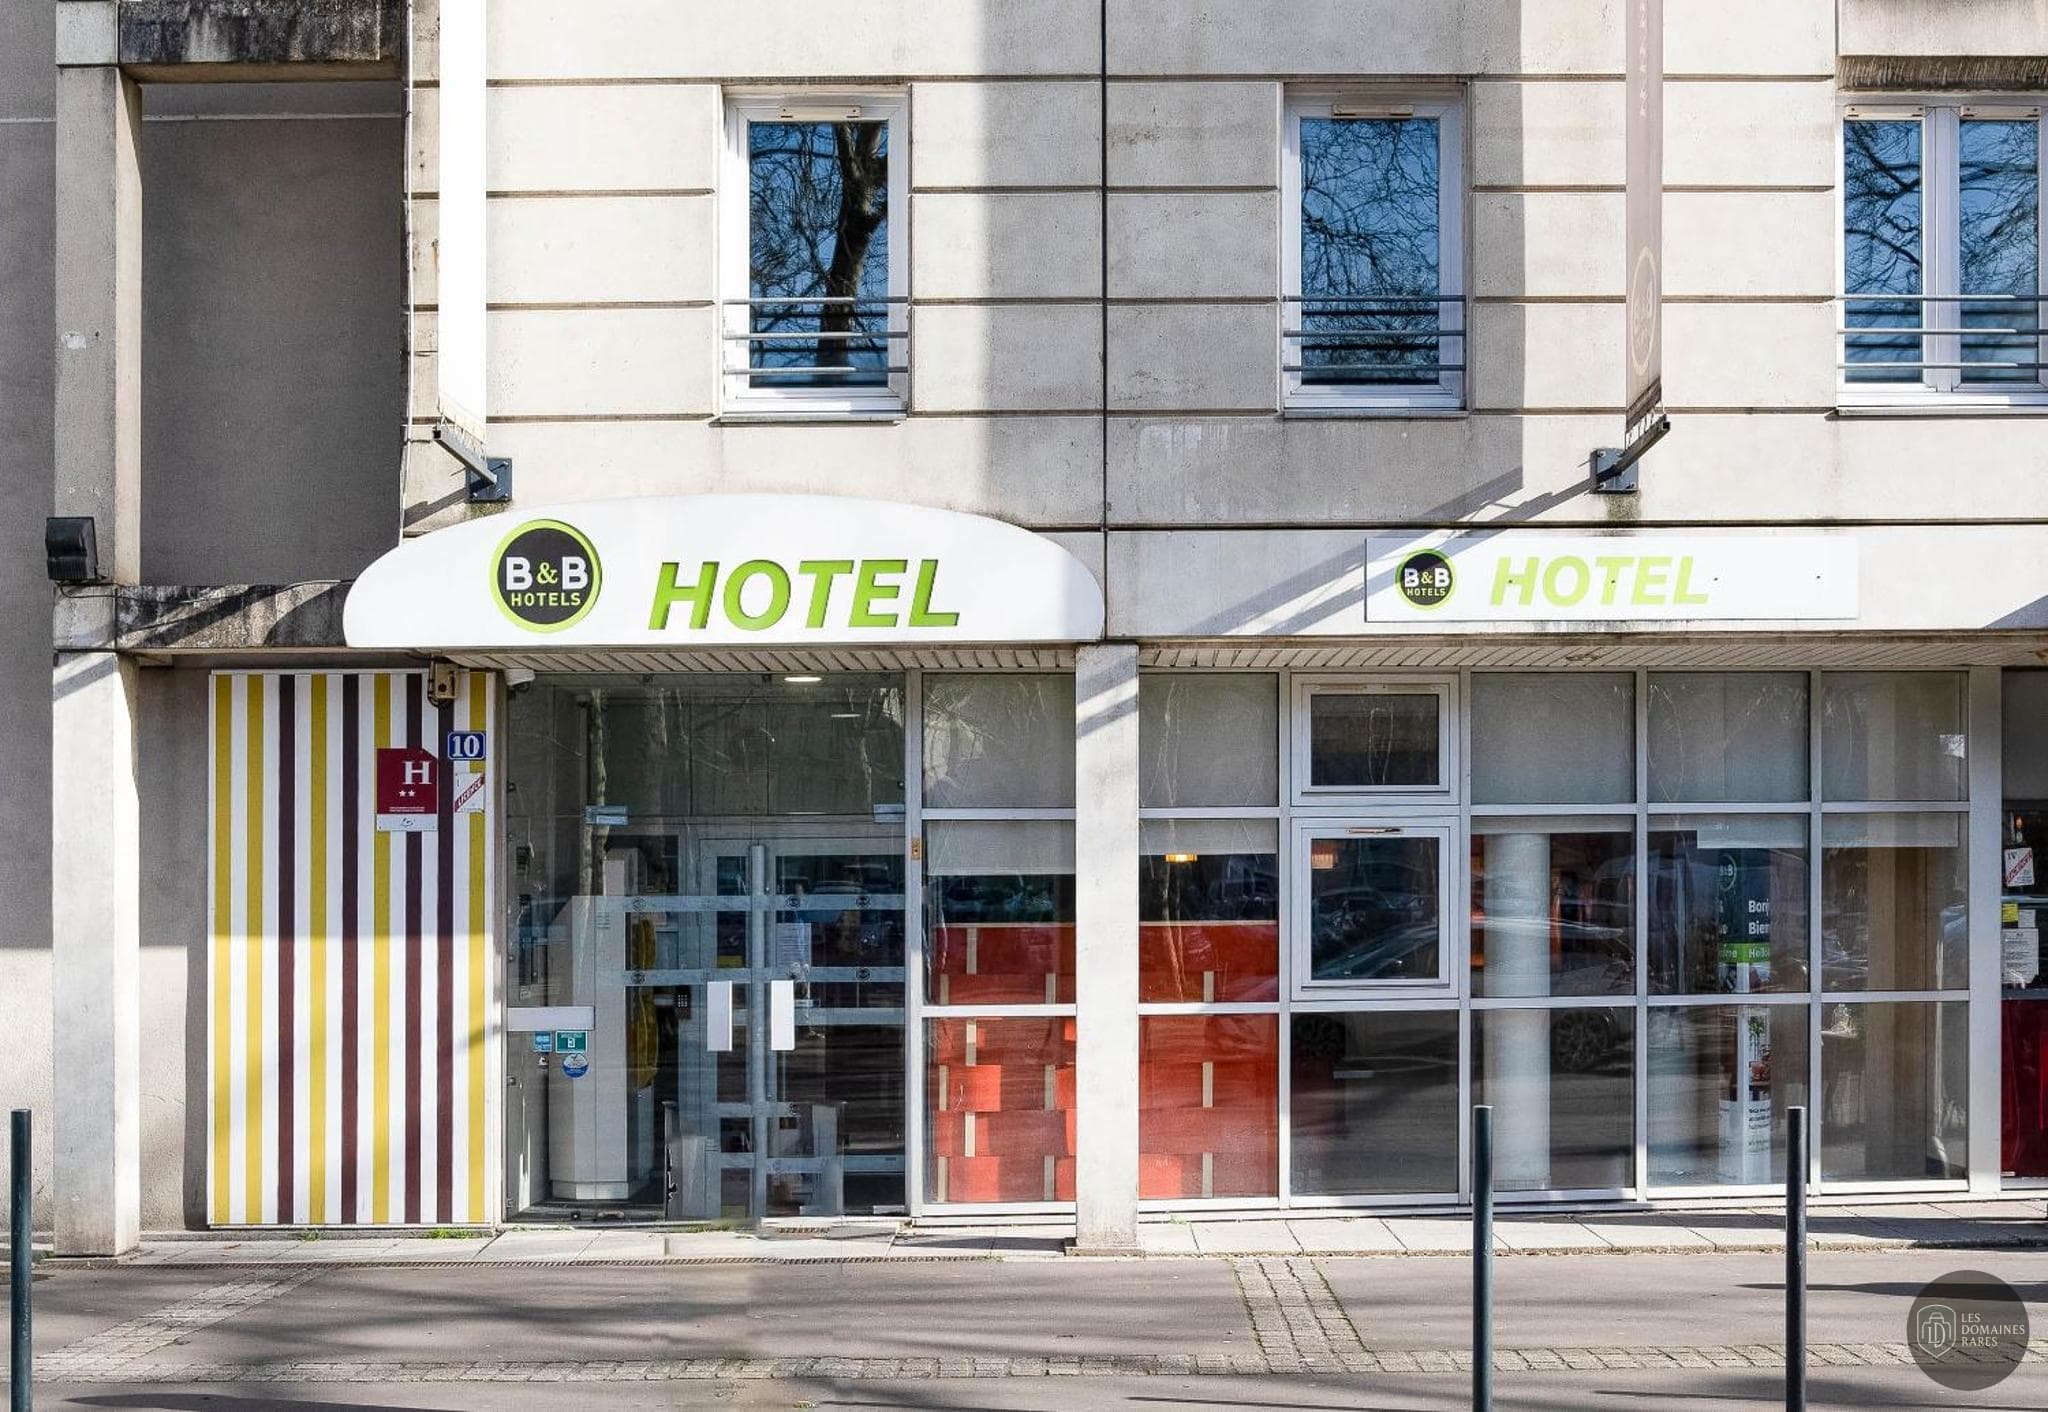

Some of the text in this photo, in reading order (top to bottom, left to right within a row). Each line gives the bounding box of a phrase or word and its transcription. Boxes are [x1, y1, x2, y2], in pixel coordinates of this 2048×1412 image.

[1407, 587, 1447, 597] HOTELS
[1490, 555, 1709, 607] HOTEL
[511, 592, 581, 607] HOTELS
[648, 559, 960, 631] HOTEL
[452, 735, 480, 758] 10
[402, 760, 432, 785] H
